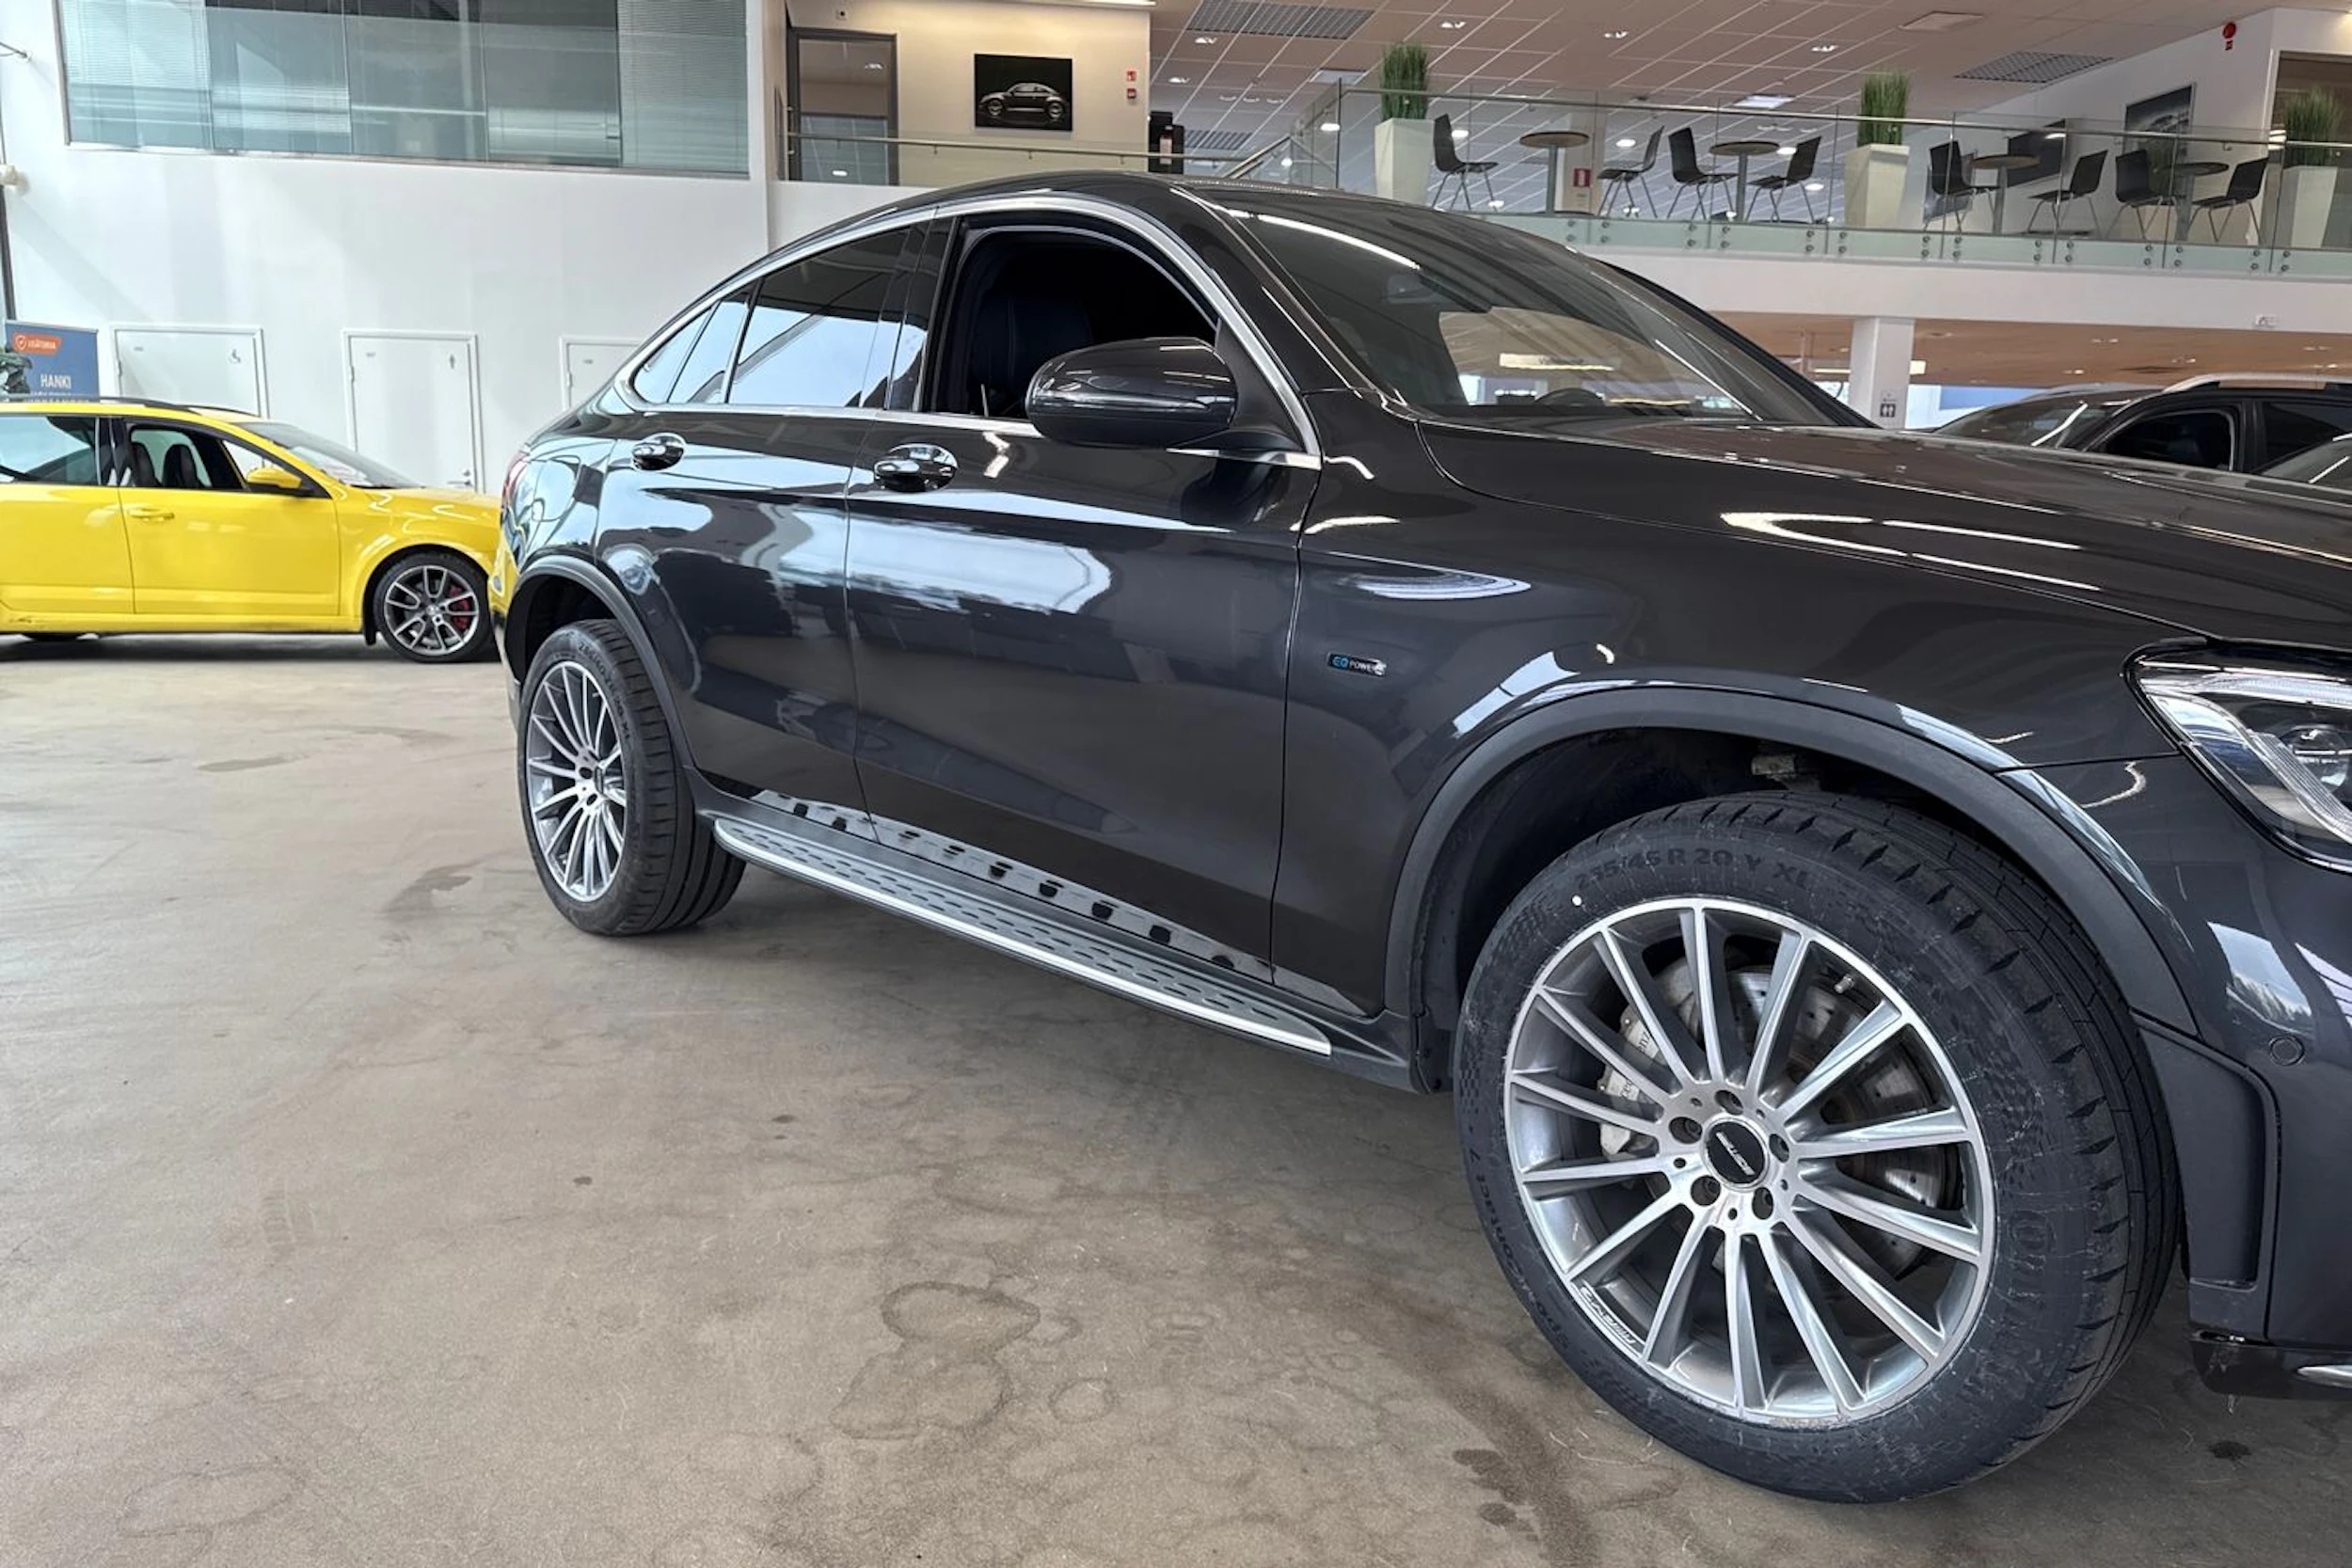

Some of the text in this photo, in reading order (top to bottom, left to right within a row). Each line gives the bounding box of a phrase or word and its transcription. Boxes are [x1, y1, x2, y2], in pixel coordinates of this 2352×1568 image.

[40, 373, 72, 389] HANKI
[1667, 848, 1686, 865] R
[1693, 847, 1733, 865] 20
[1475, 1175, 1570, 1350] SpoContact
